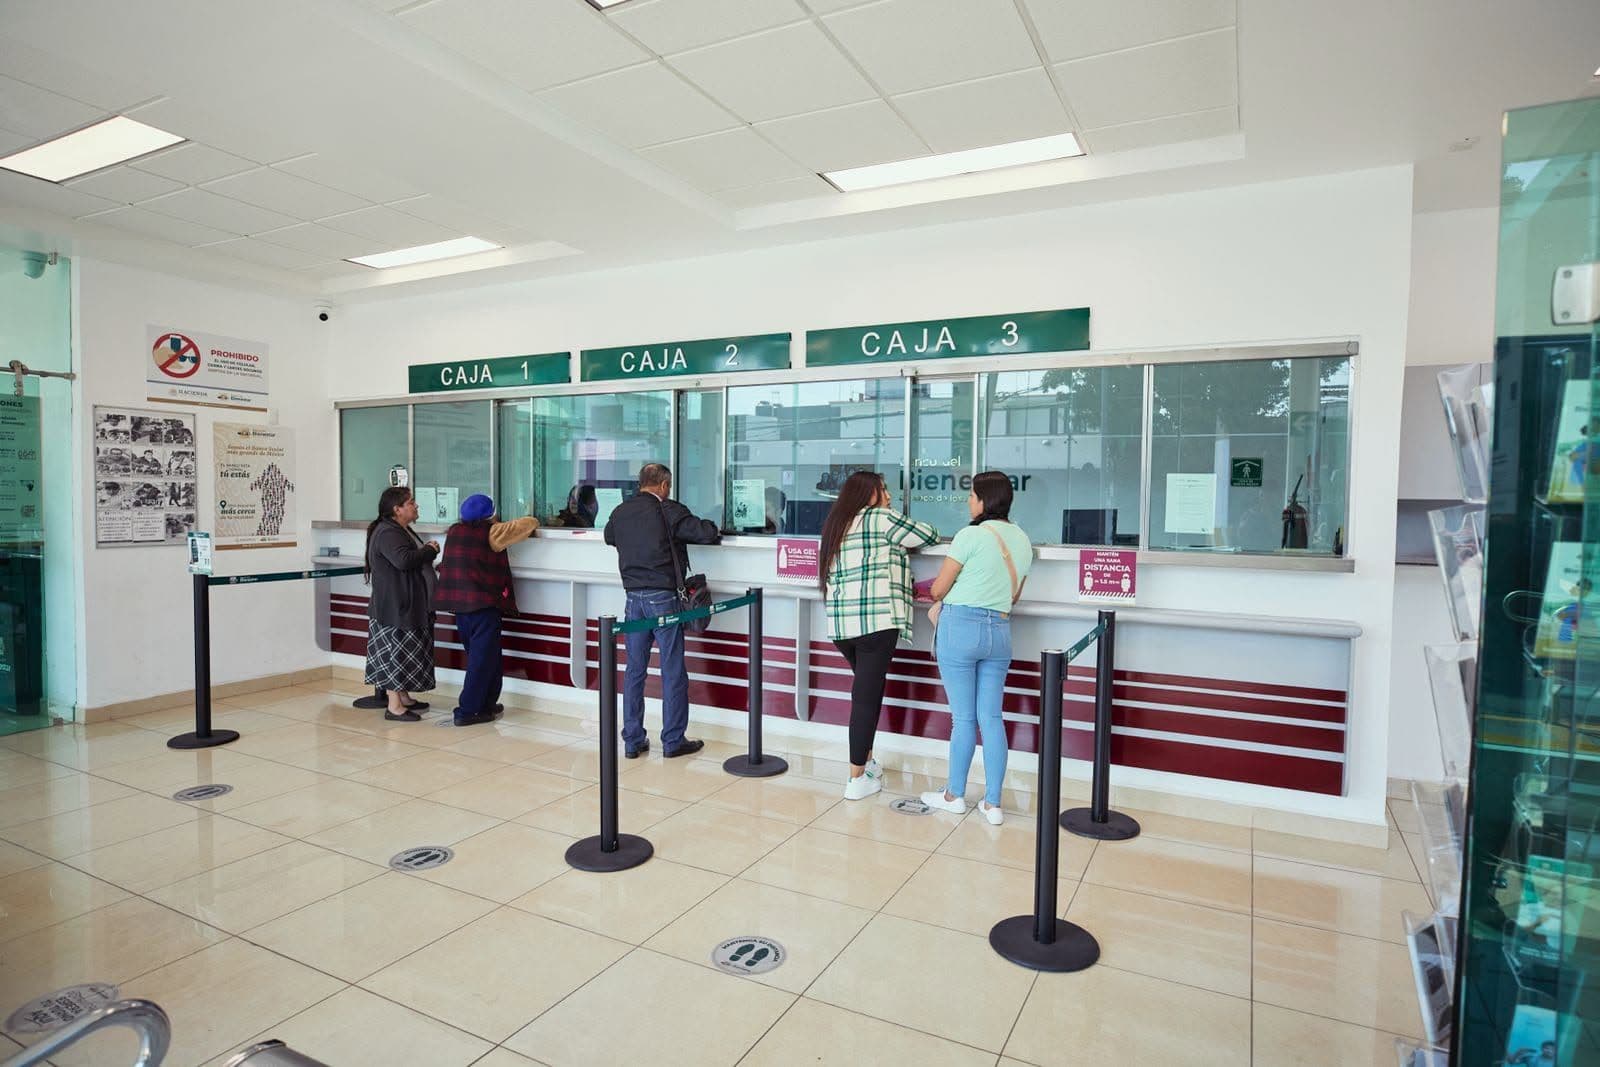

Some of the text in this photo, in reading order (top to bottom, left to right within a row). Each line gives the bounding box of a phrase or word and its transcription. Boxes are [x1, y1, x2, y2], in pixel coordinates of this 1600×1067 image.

[861, 321, 1019, 356] CAJA 3
[210, 349, 259, 362] PROHIBIDO
[620, 344, 739, 373] CAJA 2
[440, 361, 529, 386] CAJA 1
[231, 470, 250, 478] estás
[900, 469, 1032, 492] Bienear
[803, 548, 816, 556] GEL
[1084, 564, 1131, 572] DISTANCIA
